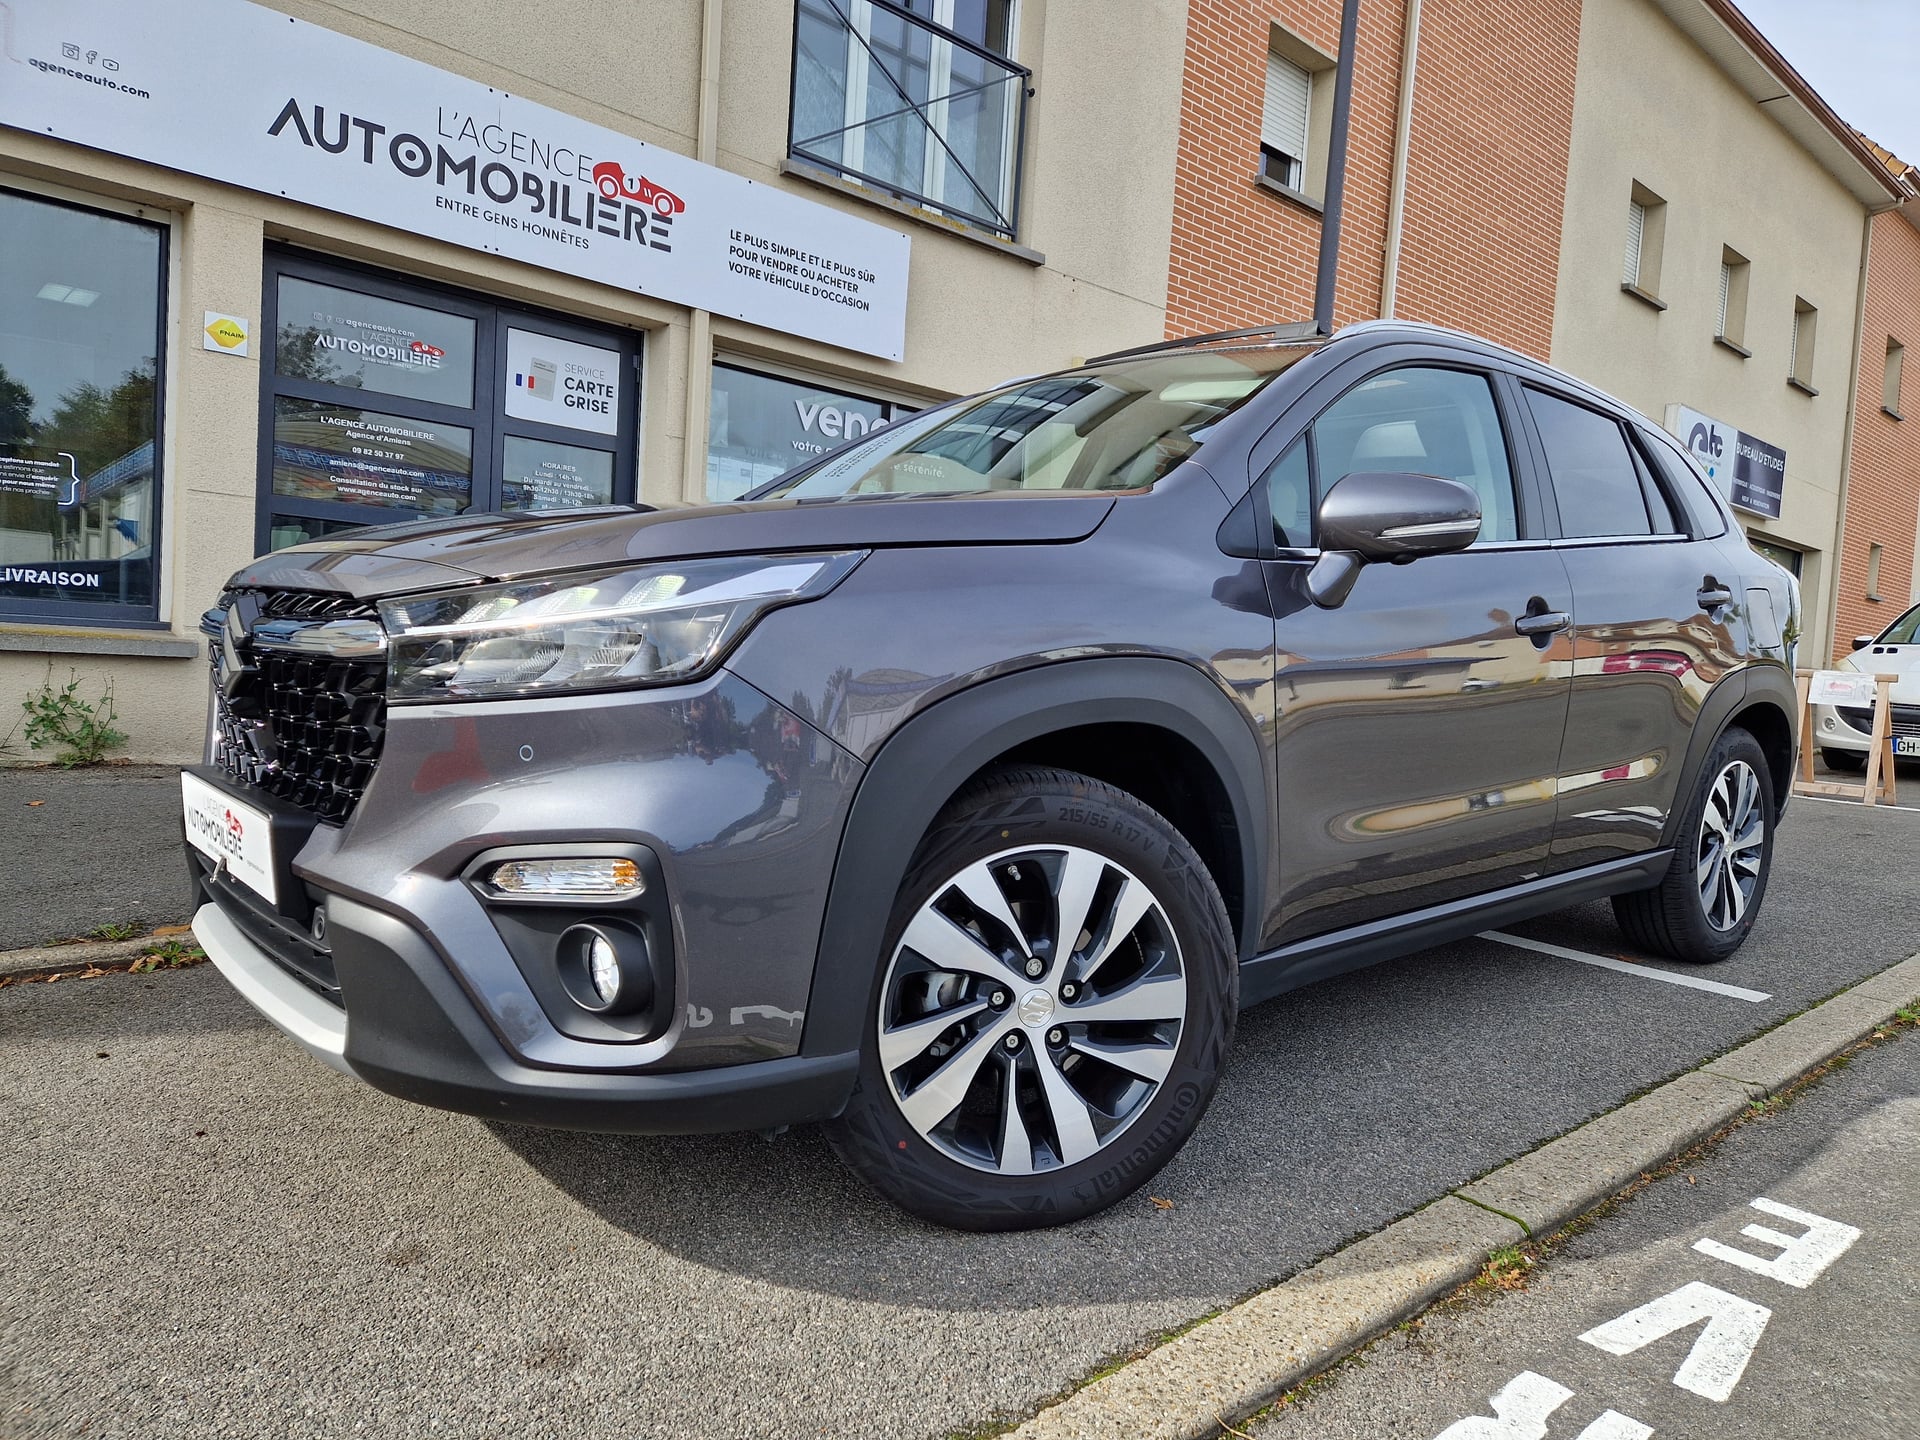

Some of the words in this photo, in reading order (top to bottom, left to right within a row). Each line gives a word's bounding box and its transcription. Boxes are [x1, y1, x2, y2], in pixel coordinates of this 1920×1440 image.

[28, 58, 150, 99] agenceauto.com
[437, 106, 593, 184] L'AGENCE
[435, 195, 479, 219] ENTRE
[483, 210, 518, 229] GENS
[522, 221, 589, 250] HONNÊTES
[730, 229, 742, 242] LE
[744, 233, 769, 250] PLUS
[771, 242, 806, 262] SIMPLE
[808, 254, 820, 266] ET
[821, 258, 832, 270] LE
[833, 262, 856, 278] PLUS
[858, 269, 876, 284] SÛR
[730, 245, 758, 263] POUR
[760, 254, 799, 275] VENDRE
[800, 267, 815, 280] OU
[817, 273, 859, 294] ACHETER
[728, 261, 762, 280] VOTRE
[763, 270, 810, 294] VÉHICULE
[812, 286, 870, 312] D'OCCASION
[220, 330, 244, 339] FNAIM
[346, 319, 415, 337] agenceauto.com
[361, 330, 412, 349] L'AGENCE
[564, 363, 605, 380] SERVICE
[564, 377, 614, 399] CARTE
[564, 394, 609, 415] GRISE
[320, 415, 365, 430] L'AGENCE
[366, 424, 435, 440] AUTOMOBILIERE
[346, 430, 375, 440] Agence
[376, 435, 412, 446] d'Amiens
[792, 440, 822, 454] votre
[352, 446, 362, 454] 09
[385, 451, 394, 459] 37
[1736, 442, 1758, 462] BUREAU
[329, 459, 425, 478] amiens@agenceauto.com
[535, 470, 553, 478] Lundi
[542, 461, 576, 472] HORAIRES
[330, 475, 378, 488] Consultation
[378, 480, 389, 489] du
[390, 482, 410, 492] stock
[534, 478, 552, 486] mardi
[563, 482, 589, 491] vendredi
[337, 486, 417, 501] www.agenceauto.com
[533, 493, 556, 502] Samedi
[1059, 807, 1110, 829] 215/55
[1112, 822, 1123, 836] R
[1126, 827, 1140, 842] 17
[1143, 837, 1155, 851] V
[1089, 1081, 1200, 1198] Continental
